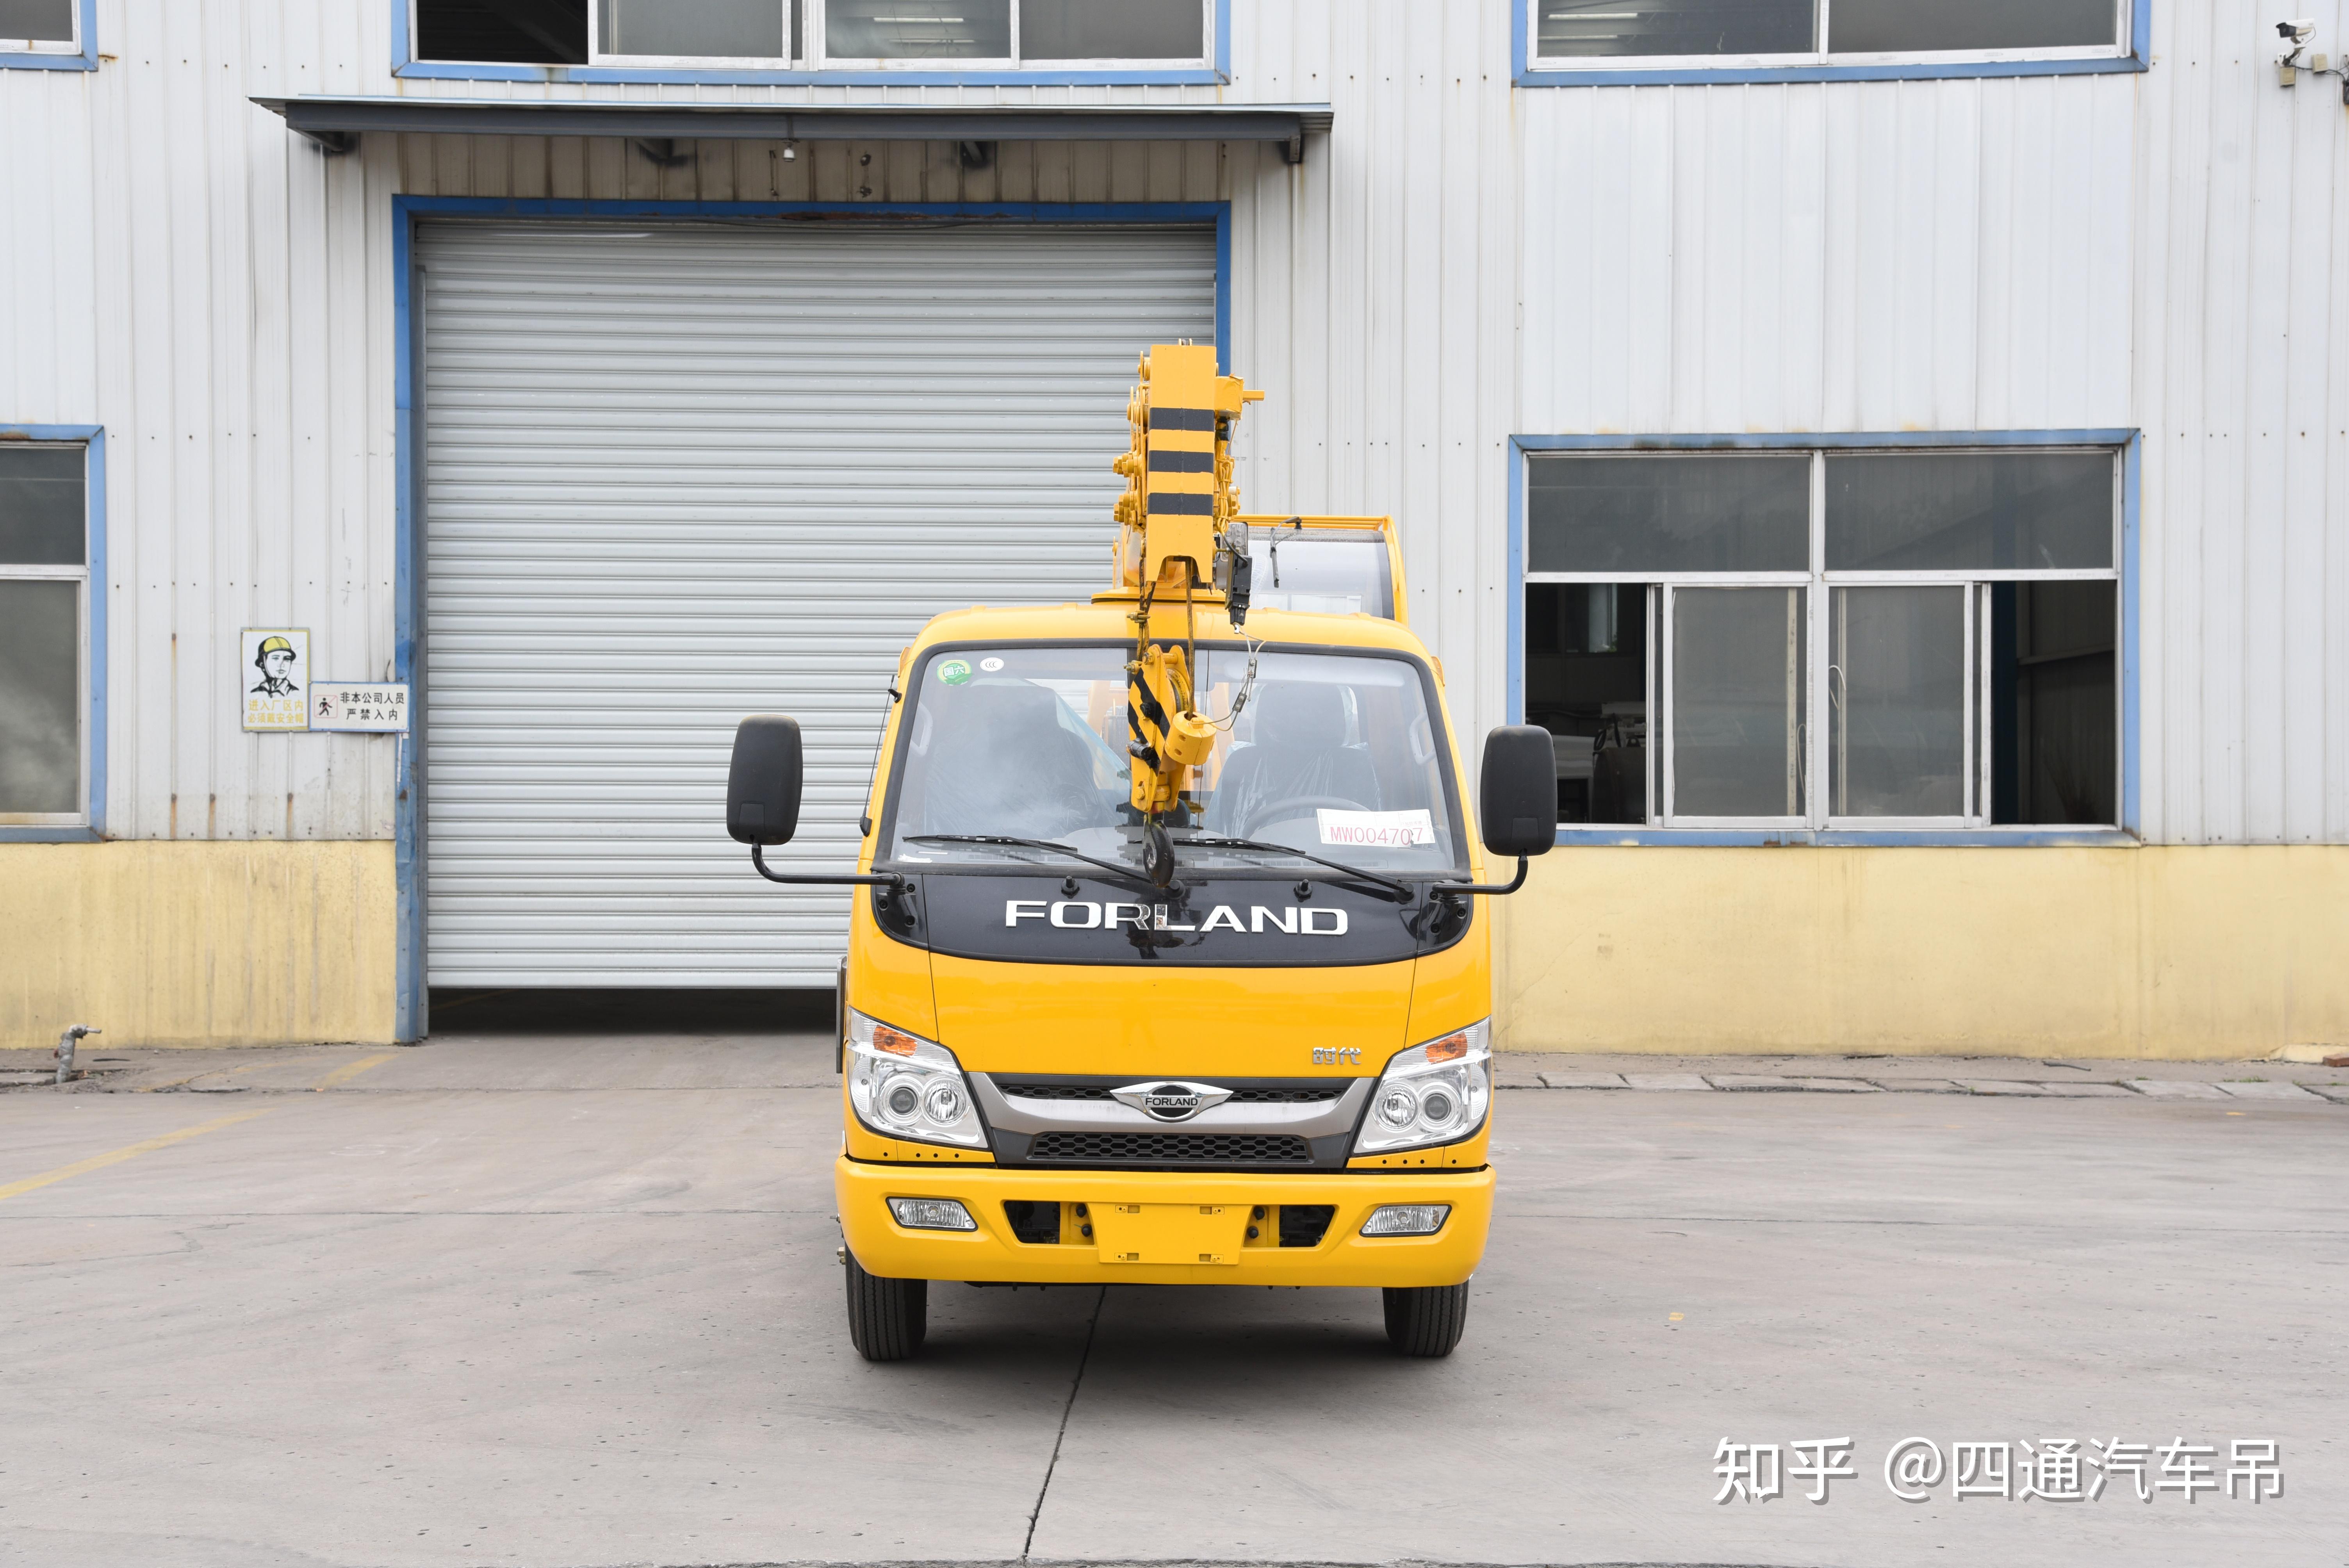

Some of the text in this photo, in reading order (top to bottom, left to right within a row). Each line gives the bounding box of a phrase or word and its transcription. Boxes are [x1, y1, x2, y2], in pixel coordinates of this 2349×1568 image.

[943, 665, 964, 677] 国六
[340, 691, 405, 704] 非本公司人员
[249, 699, 303, 711] 进入厂区内
[346, 708, 397, 720] 严禁入内
[1330, 827, 1423, 845] MW004707
[1005, 900, 1348, 936] FORLAND
[1313, 1047, 1361, 1065] 时代
[1145, 1098, 1198, 1106] FORLAND
